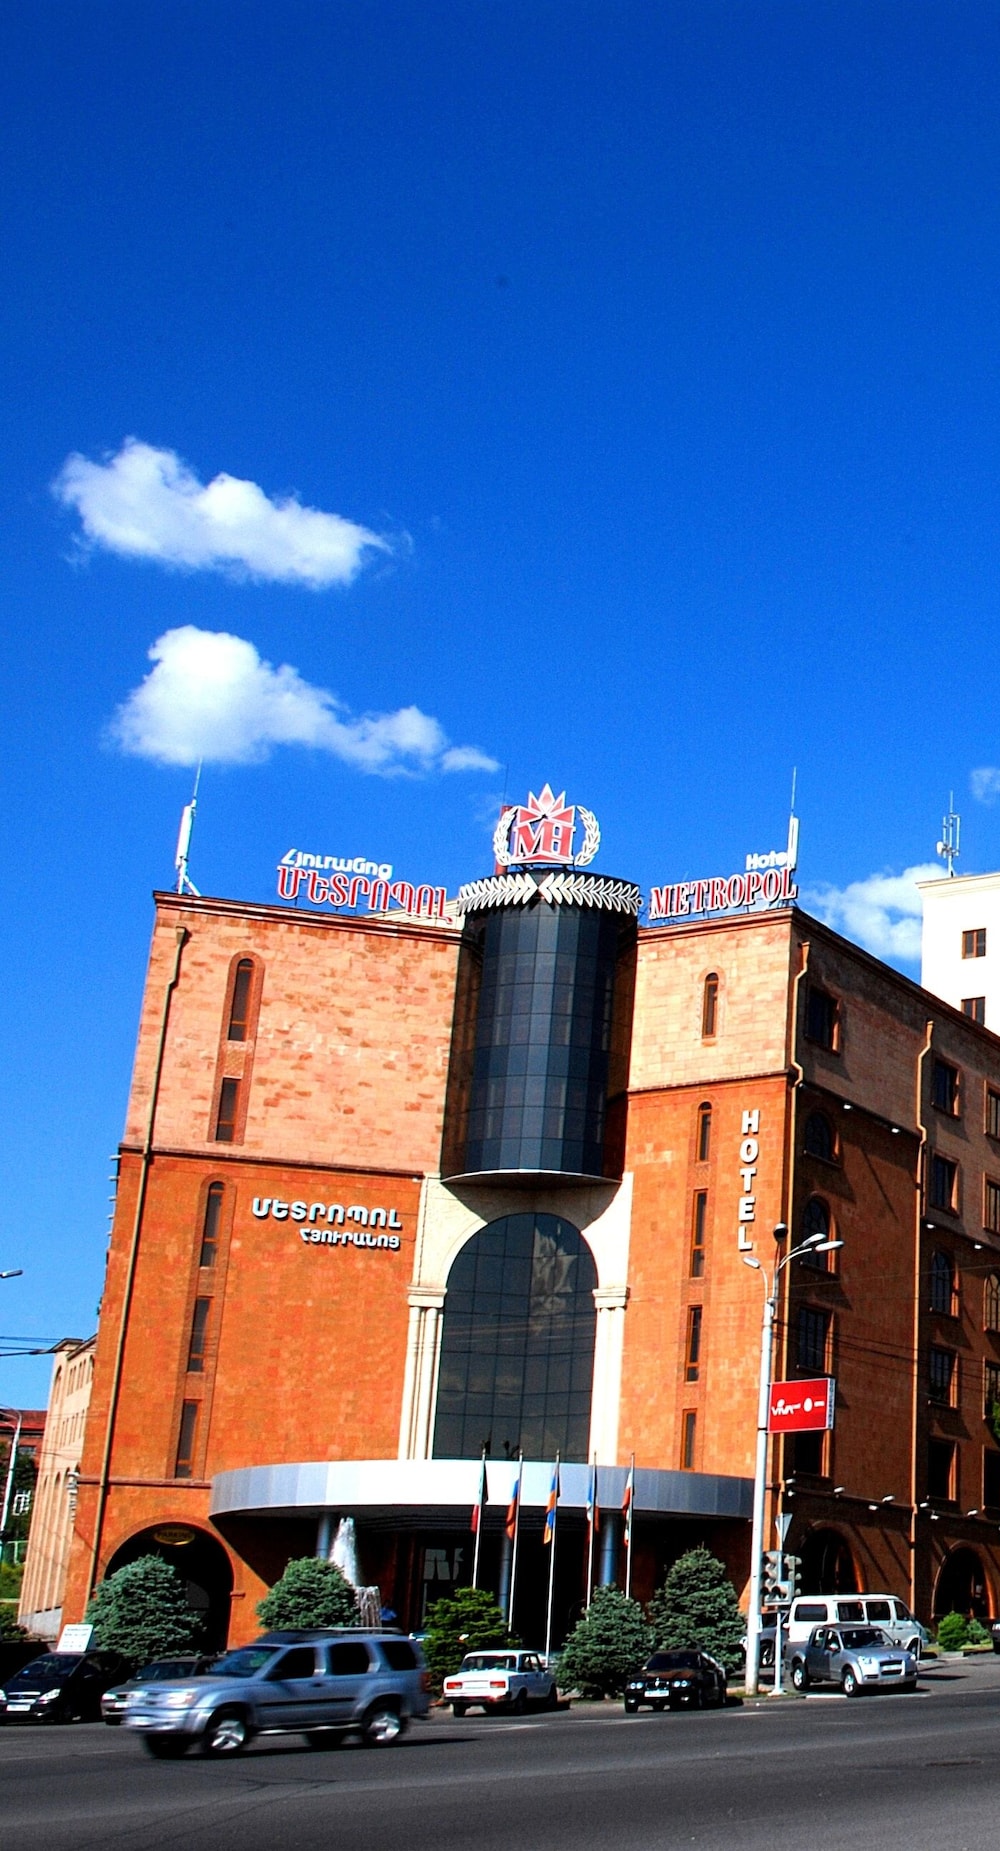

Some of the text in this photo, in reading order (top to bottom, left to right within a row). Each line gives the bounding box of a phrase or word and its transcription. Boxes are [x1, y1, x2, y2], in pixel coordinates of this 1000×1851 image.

[277, 865, 453, 924] ՄԵՏՐՈՊՈԼ
[650, 866, 797, 920] METROPOL
[738, 1109, 760, 1251] HOTEL
[252, 1197, 402, 1229] ՄԵՏՐՈՊՈԼ
